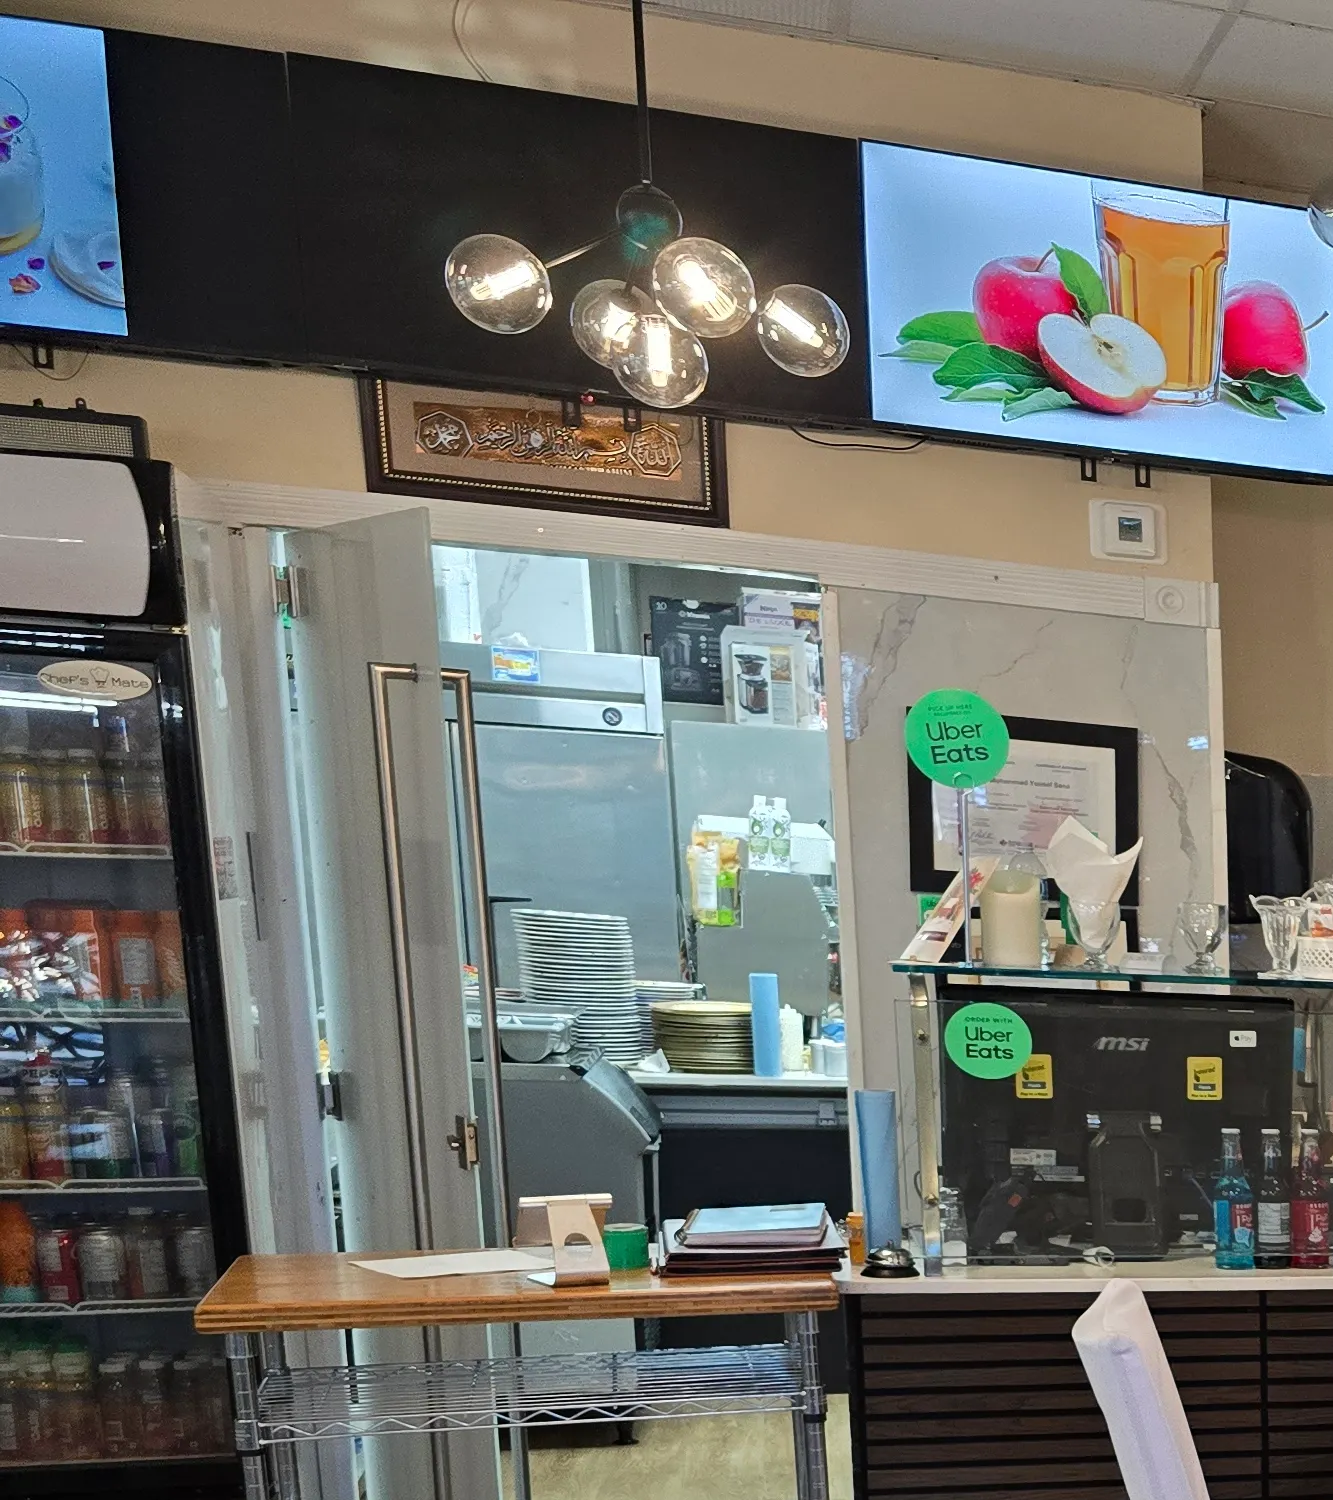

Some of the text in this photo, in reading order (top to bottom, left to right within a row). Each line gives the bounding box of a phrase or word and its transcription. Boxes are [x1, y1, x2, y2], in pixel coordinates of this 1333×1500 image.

[111, 676, 150, 689] Mate
[925, 721, 984, 742] Uber
[930, 743, 990, 765] Eats
[964, 1025, 1013, 1042] Uber
[965, 1043, 1014, 1060] Eats
[1095, 1036, 1150, 1051] msi
